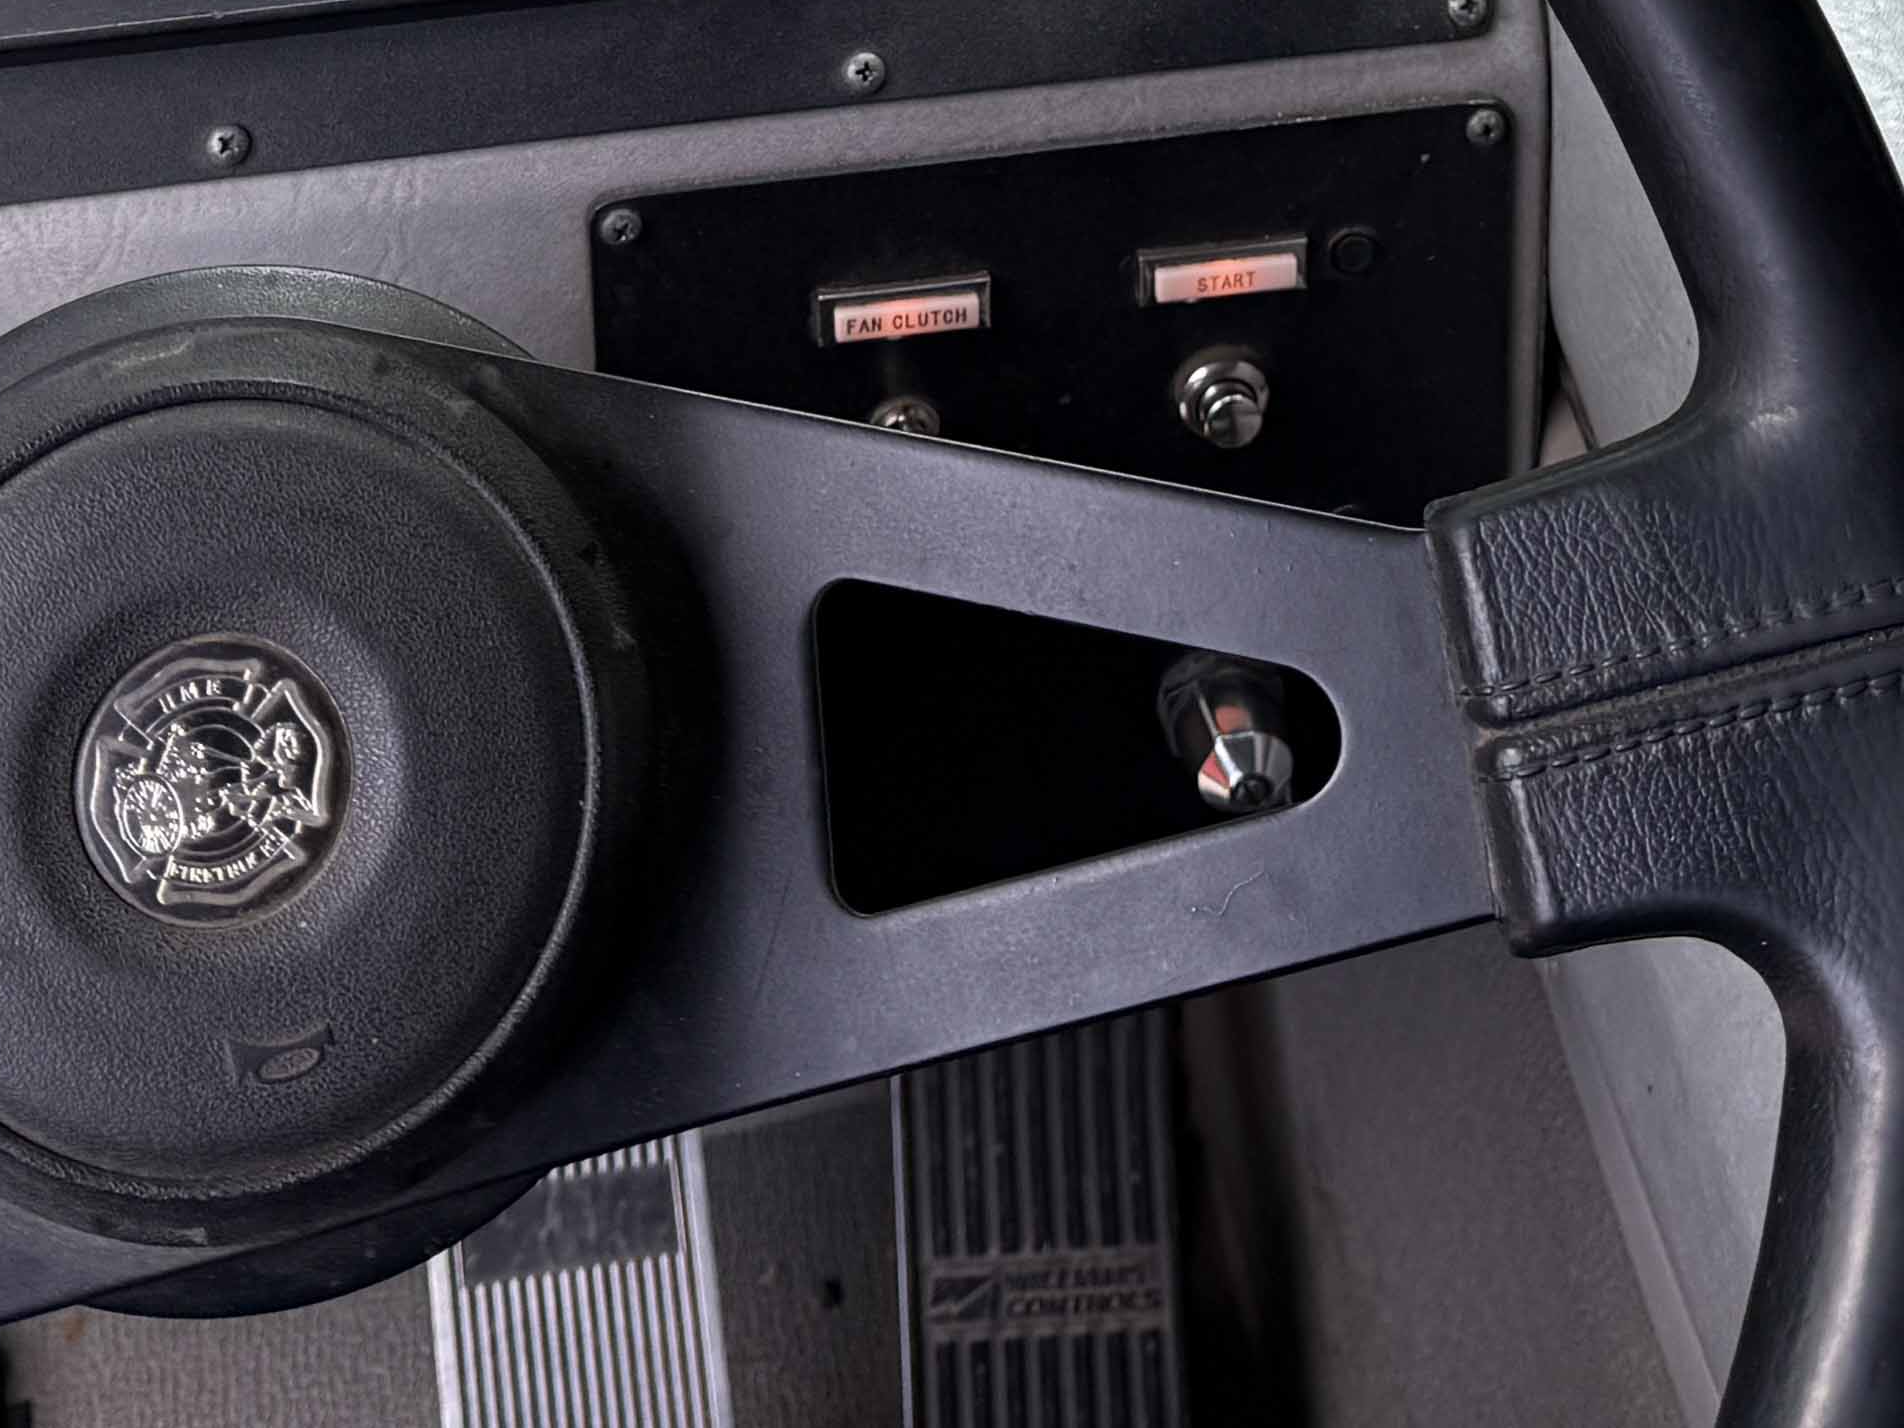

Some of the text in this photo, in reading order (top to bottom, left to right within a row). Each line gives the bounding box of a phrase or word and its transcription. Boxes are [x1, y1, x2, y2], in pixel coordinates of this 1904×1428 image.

[1197, 270, 1258, 292] START
[845, 307, 969, 335] FAN CLUTCH
